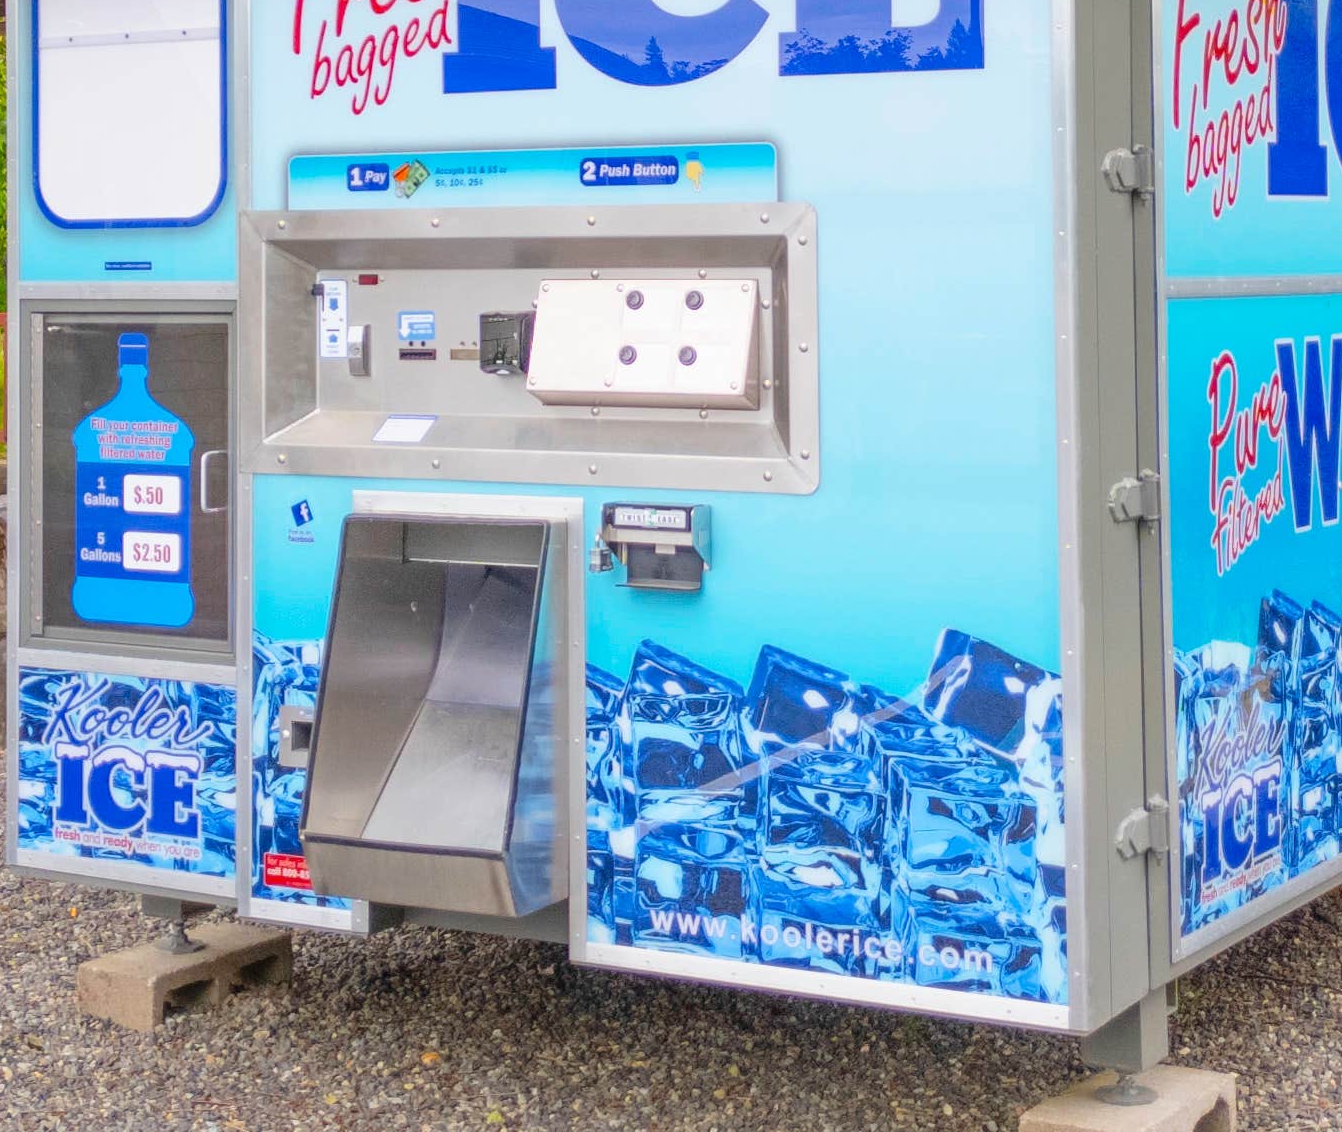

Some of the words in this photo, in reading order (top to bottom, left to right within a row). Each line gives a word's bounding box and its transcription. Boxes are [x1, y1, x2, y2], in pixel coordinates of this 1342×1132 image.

[1185, 54, 1274, 218] bagged
[350, 167, 363, 186] 1
[365, 171, 387, 185] Pay
[583, 161, 596, 181] 2
[599, 164, 630, 177] Push
[633, 163, 676, 176] Button
[92, 419, 105, 429] Fill
[109, 422, 127, 431] your
[132, 422, 177, 432] container
[1209, 351, 1286, 511] Pure
[98, 434, 117, 445] with
[122, 435, 171, 448] refreshing
[101, 448, 134, 459] filtered
[138, 451, 164, 460] water
[97, 477, 106, 489] 1
[84, 493, 119, 507] Gallon
[134, 486, 163, 505] $.50
[97, 532, 105, 545] 5
[81, 548, 121, 563] Gallons
[134, 543, 171, 563] $2.50
[43, 681, 212, 744] Kooler
[1196, 706, 1284, 800] Kooler
[56, 742, 201, 838] ICE
[1202, 760, 1281, 882] ICE
[55, 827, 80, 840] fresh
[83, 833, 100, 844] and
[104, 834, 132, 851] ready
[136, 840, 161, 851] when
[164, 844, 181, 857] you
[184, 848, 200, 857] are
[651, 908, 993, 973] www.koolerice.com
